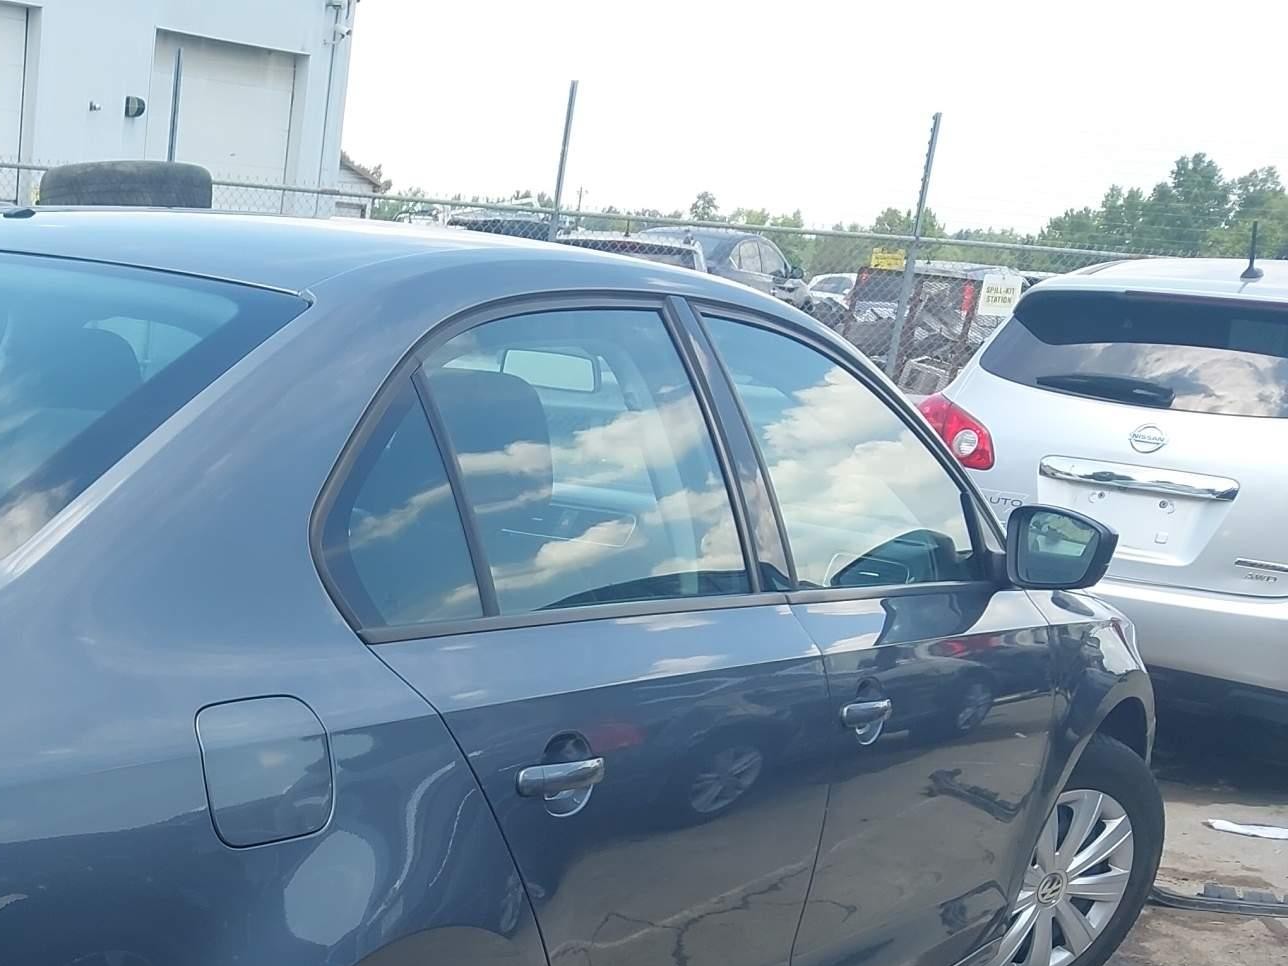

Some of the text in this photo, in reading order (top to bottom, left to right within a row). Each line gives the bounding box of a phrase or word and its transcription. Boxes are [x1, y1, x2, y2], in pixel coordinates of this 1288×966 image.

[986, 295, 1012, 304] STATION
[1132, 432, 1165, 442] NISSAN
[986, 496, 1023, 507] UTO
